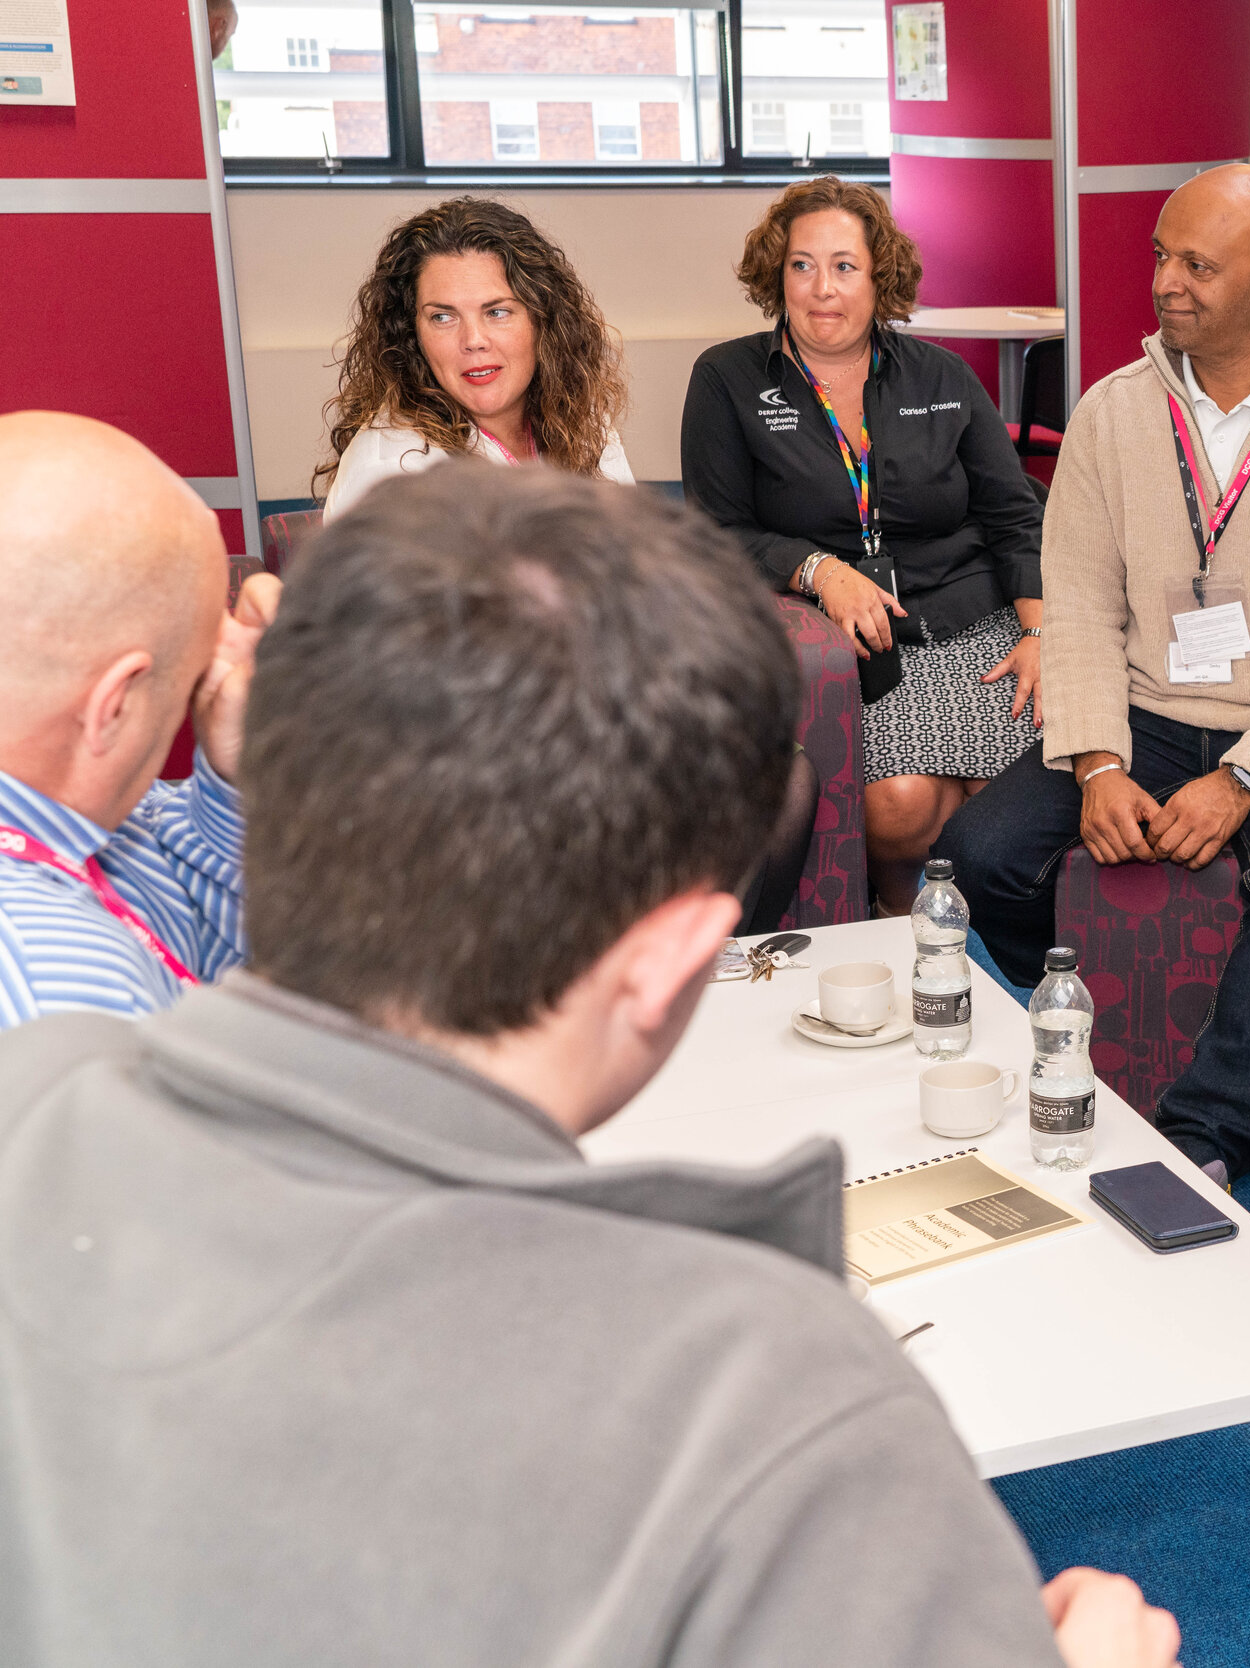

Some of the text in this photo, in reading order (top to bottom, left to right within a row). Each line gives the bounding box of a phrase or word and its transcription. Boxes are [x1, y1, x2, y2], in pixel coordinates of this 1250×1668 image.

[899, 401, 961, 416] Clarissa Crossley
[765, 416, 799, 425] Engineering
[769, 424, 797, 432] Academy
[1214, 488, 1238, 525] DCG Visitor
[902, 1218, 953, 1250] Phrasebank
[923, 1213, 967, 1238] Academic
